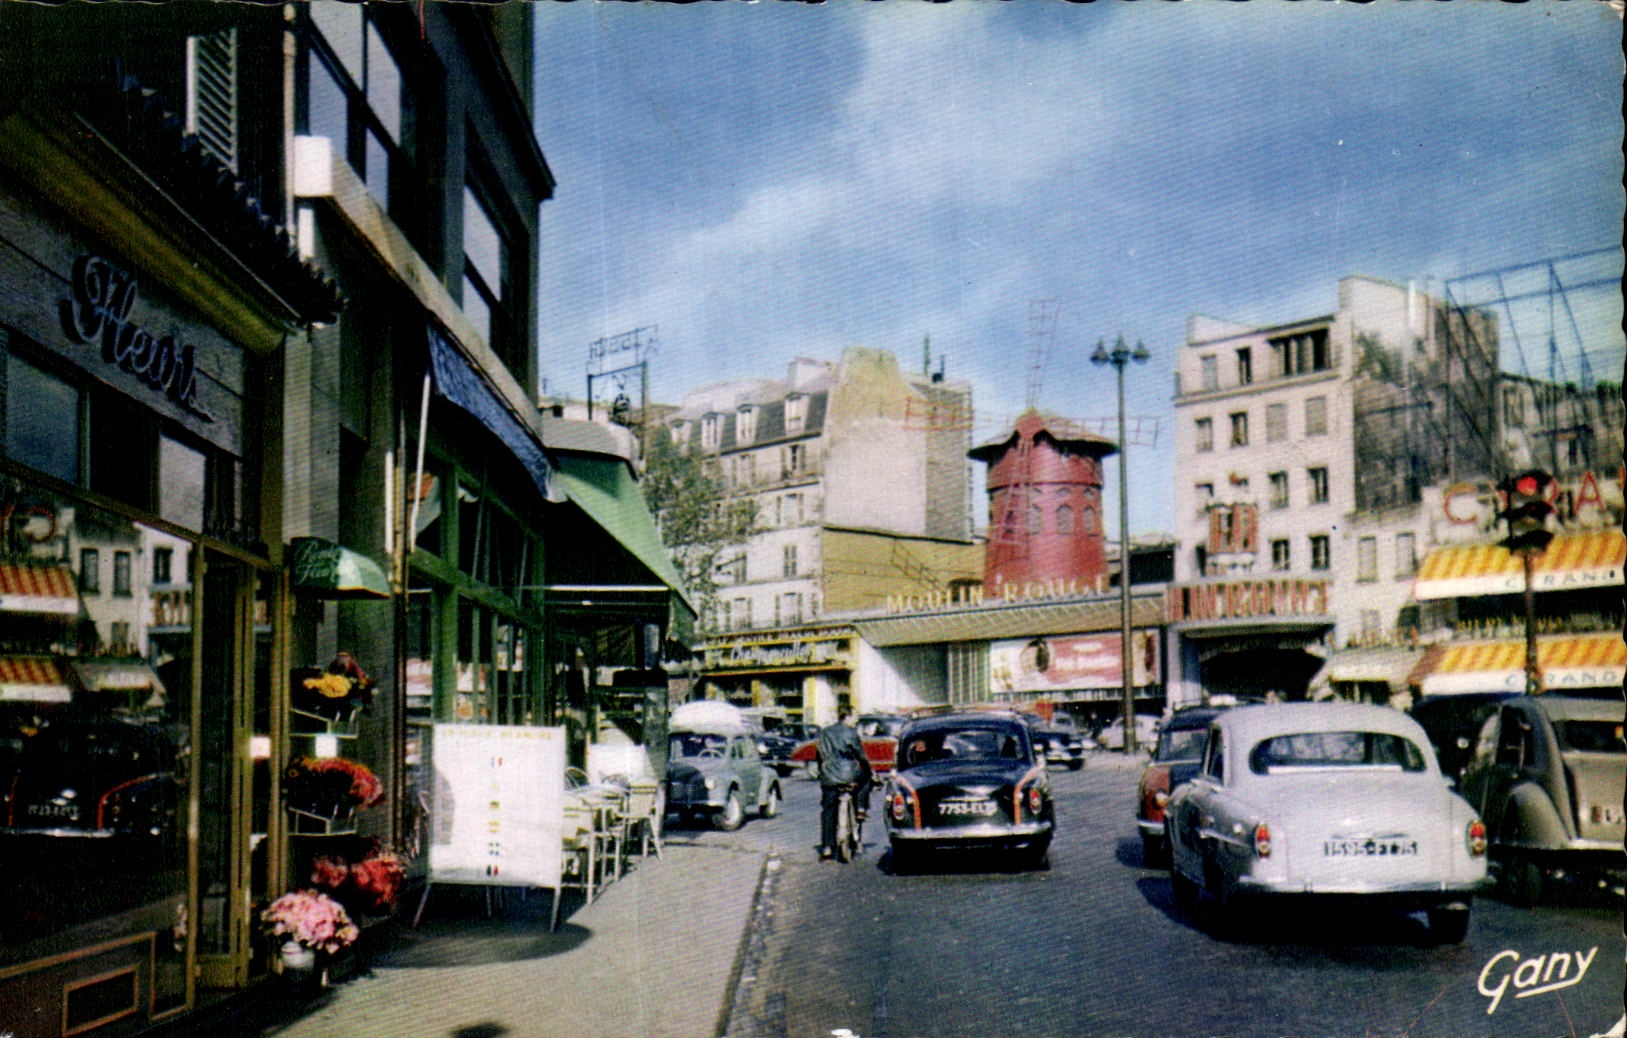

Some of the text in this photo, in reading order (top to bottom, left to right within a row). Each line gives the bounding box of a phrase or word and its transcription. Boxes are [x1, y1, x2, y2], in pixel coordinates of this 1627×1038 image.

[1505, 571, 1615, 588] CRANO
[886, 573, 1112, 615] MOULIN ROUGE
[1505, 671, 1616, 687] CRANO
